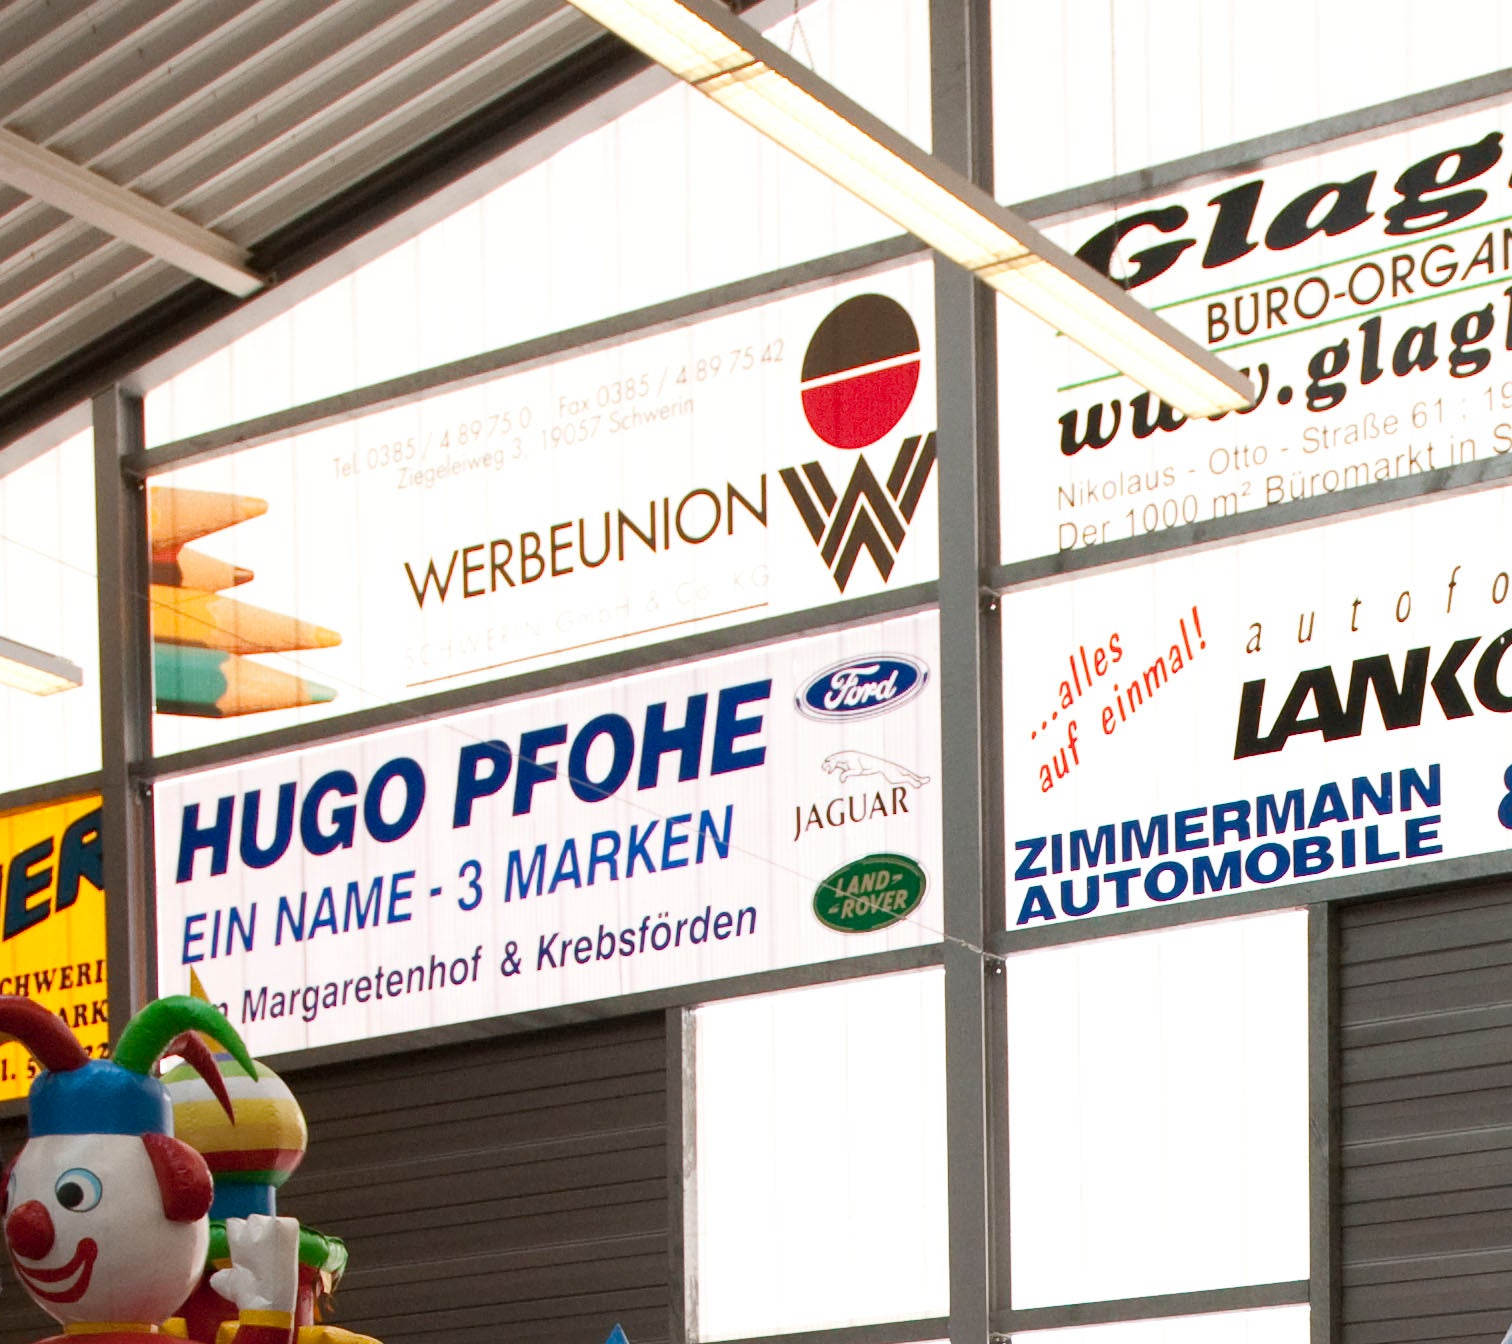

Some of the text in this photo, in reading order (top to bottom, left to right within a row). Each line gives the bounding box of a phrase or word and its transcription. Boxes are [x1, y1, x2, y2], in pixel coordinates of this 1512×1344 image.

[366, 436, 418, 471] 0385
[439, 428, 451, 449] 4
[458, 419, 483, 446] 89
[488, 410, 513, 438] 75
[518, 405, 532, 429] 0
[557, 395, 590, 419] Fax
[596, 373, 651, 409] 0385
[675, 365, 688, 386] 4
[695, 354, 722, 383] 89
[729, 345, 755, 375] 75
[760, 337, 785, 364] 42
[541, 415, 601, 451] 19057
[608, 396, 695, 434] Schwerin
[1058, 465, 1176, 511] Nikolaus
[1208, 444, 1268, 475] Otto
[1301, 412, 1399, 454] Straße
[1411, 396, 1444, 429] 61
[404, 473, 768, 611] WERBEUNION
[1058, 517, 1111, 553] Der
[1126, 494, 1198, 538] 1000
[1265, 442, 1437, 507] Büromarkt
[1450, 434, 1477, 466] in
[823, 663, 900, 710] Ford
[1039, 605, 1206, 793] auf einmal!
[175, 678, 773, 884] HUGO PFOHE
[793, 786, 909, 842] JAGUAR
[1015, 764, 1442, 881] ZIMMERMANN
[181, 898, 259, 965] EIN
[275, 867, 416, 946] NAME
[458, 861, 485, 912] 3
[504, 804, 735, 903] MARKEN
[1016, 814, 1443, 926] AUTOMOBILE
[241, 902, 759, 1025] Margaretenhof & Krebsförden
